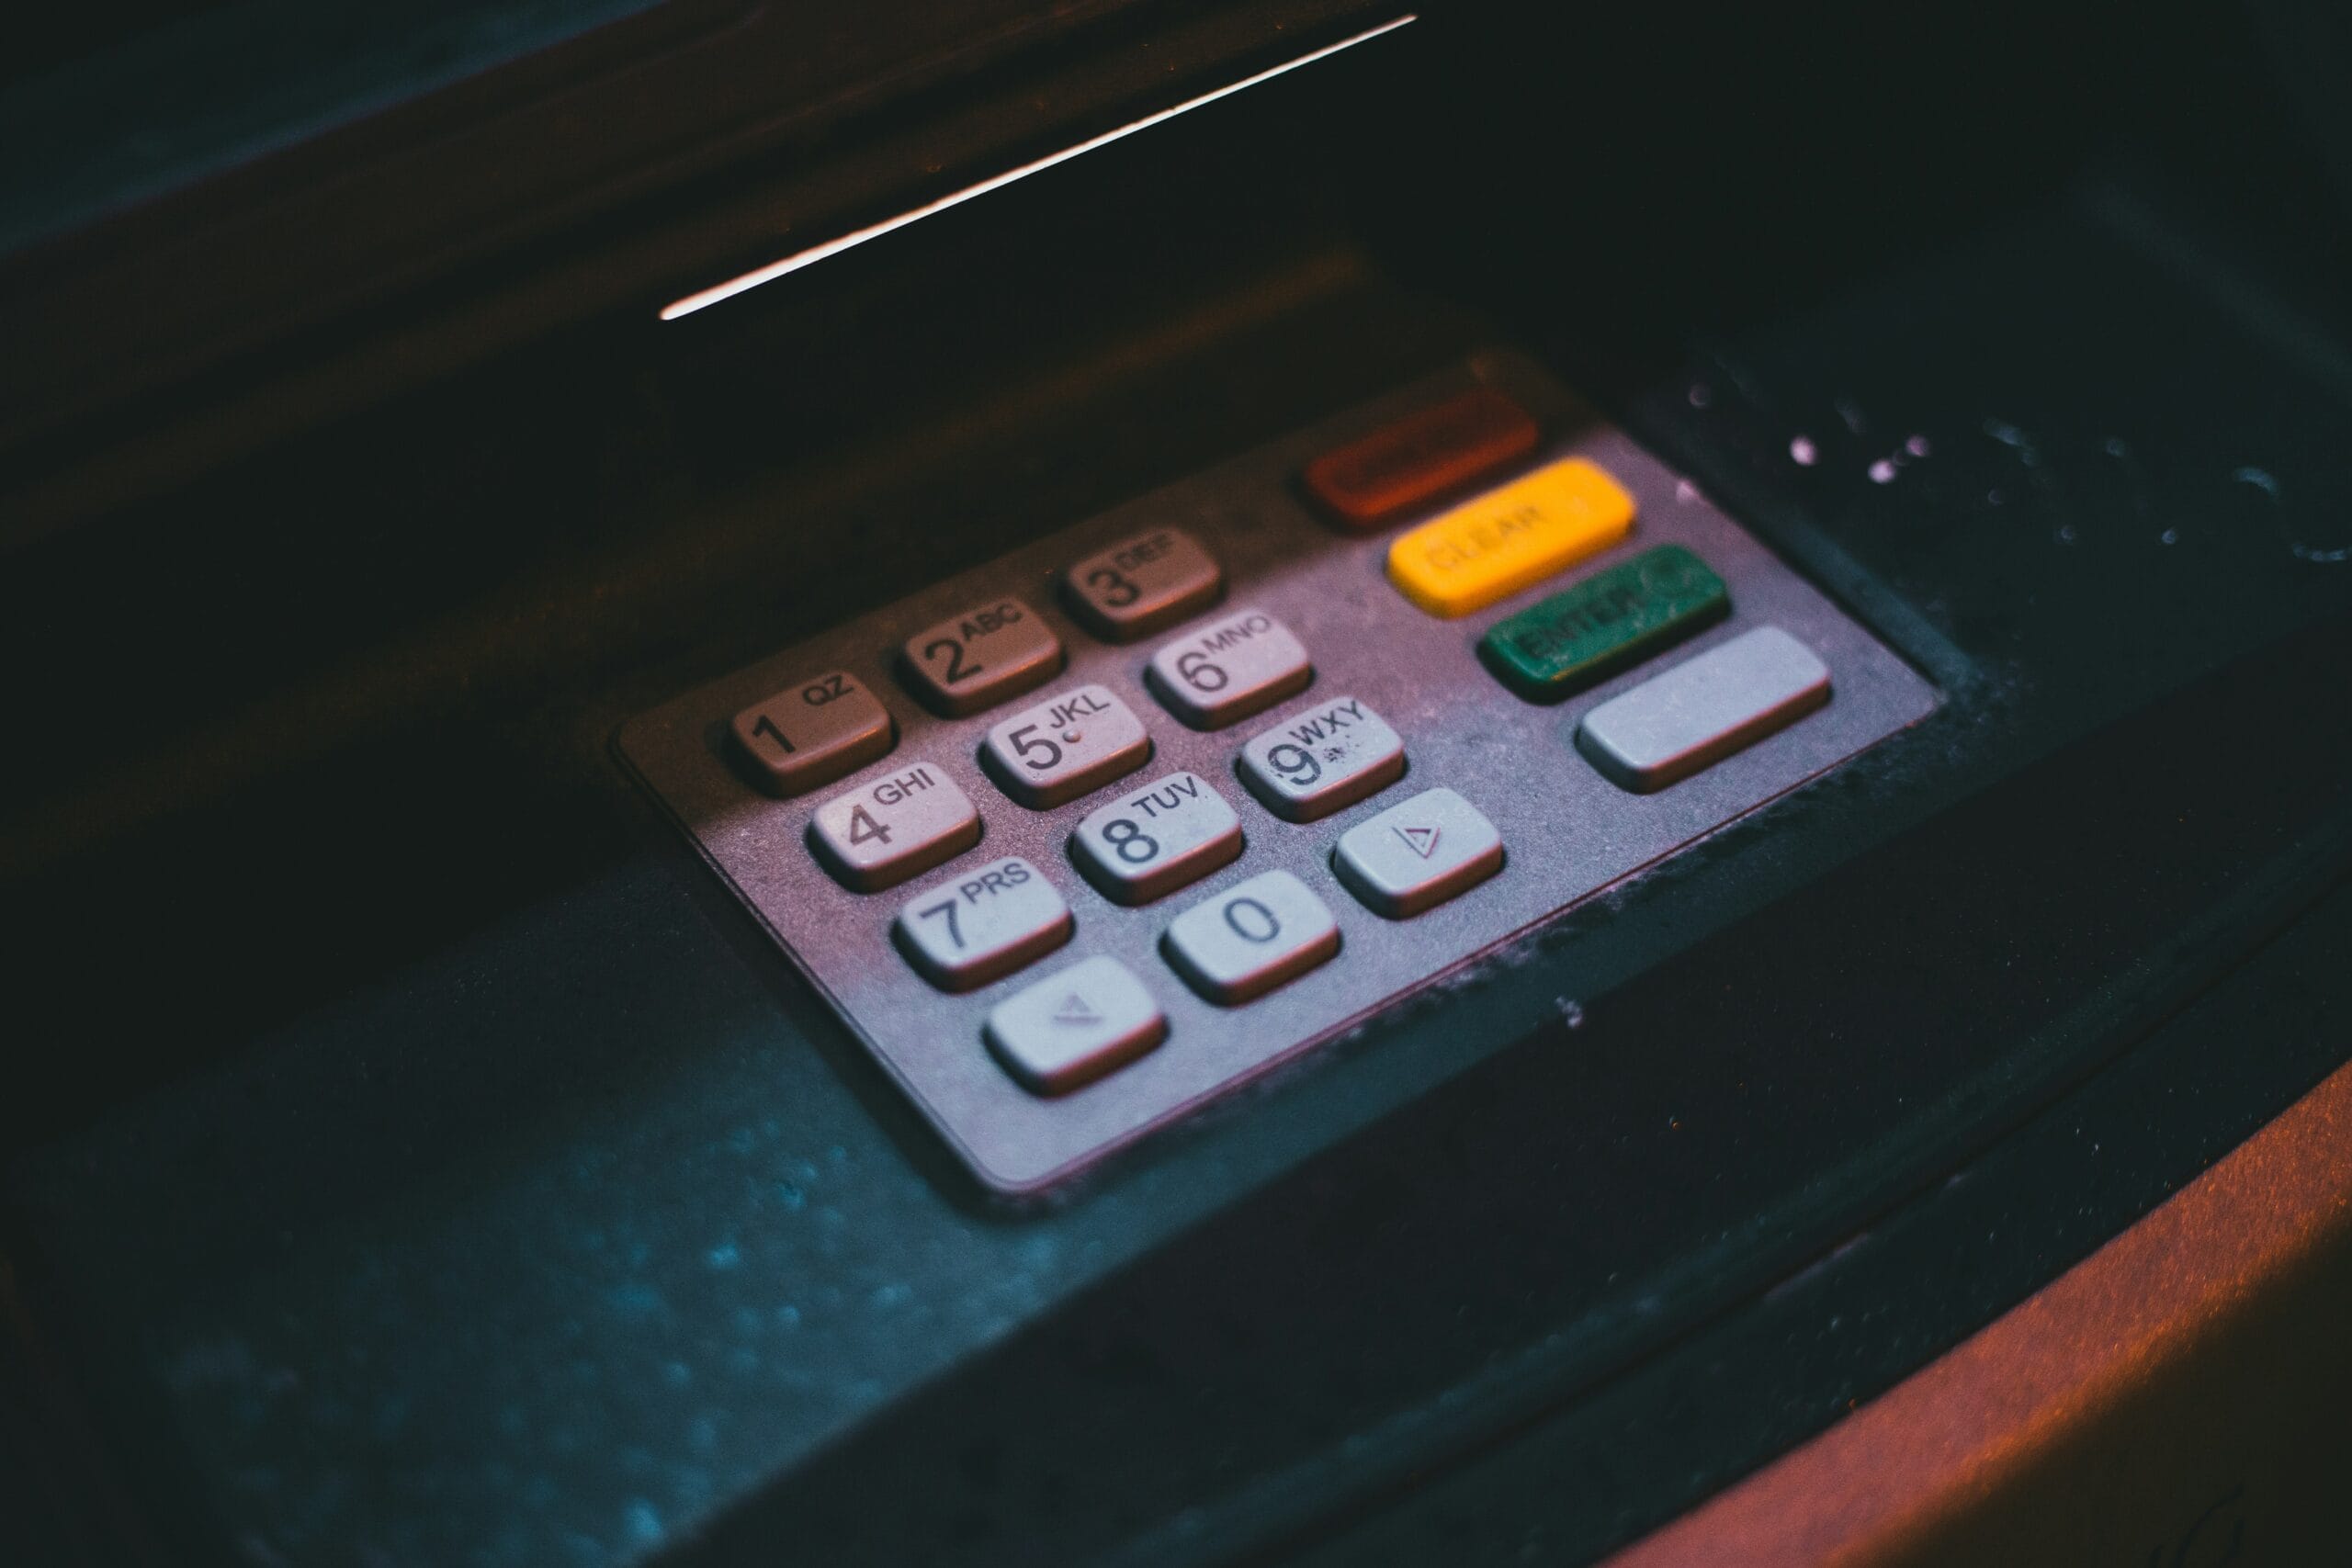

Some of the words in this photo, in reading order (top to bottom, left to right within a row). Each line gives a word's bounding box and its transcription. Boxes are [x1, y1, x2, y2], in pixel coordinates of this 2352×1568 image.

[1088, 570, 1141, 607] 3
[925, 638, 982, 683] 2
[960, 604, 1023, 641] ABC
[1202, 615, 1271, 654] MNO
[1177, 652, 1228, 692] 6
[752, 715, 796, 753] 1
[802, 674, 854, 705] QZ
[1009, 724, 1062, 770] 5
[1050, 694, 1111, 728] JKL
[1288, 701, 1363, 745] WXY
[1268, 744, 1321, 785] 9
[850, 804, 892, 846] 4
[873, 768, 935, 806] GHI
[1102, 818, 1159, 863] 8
[1131, 776, 1198, 818] TUV
[920, 899, 967, 949] 7
[960, 863, 1031, 904] PRS
[1223, 897, 1281, 942] 0
